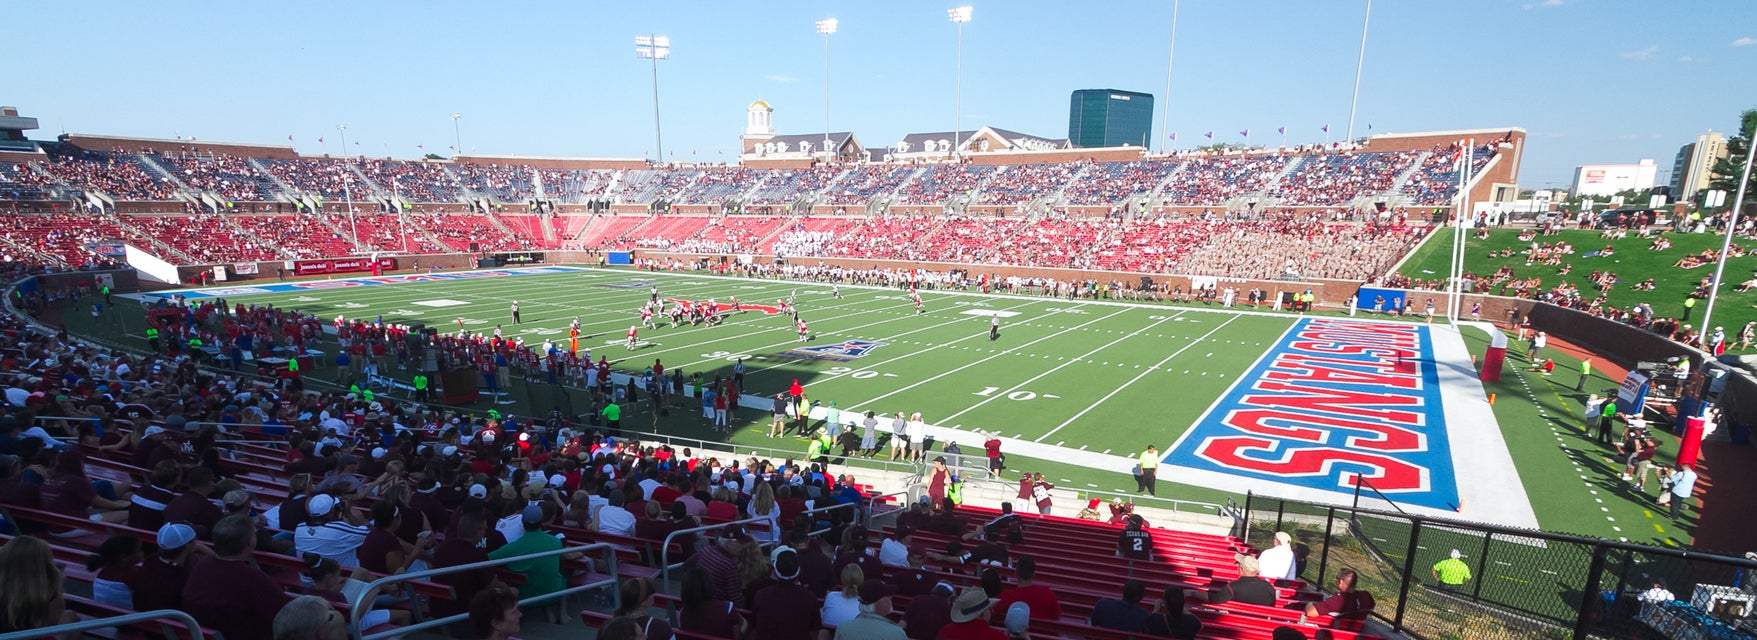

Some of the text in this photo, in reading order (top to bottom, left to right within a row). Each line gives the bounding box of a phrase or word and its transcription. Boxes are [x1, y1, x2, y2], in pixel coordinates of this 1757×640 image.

[818, 366, 879, 379] 20
[971, 386, 1037, 401] 10
[1193, 318, 1432, 493] MUSTANGS
[1133, 538, 1143, 551] 2
